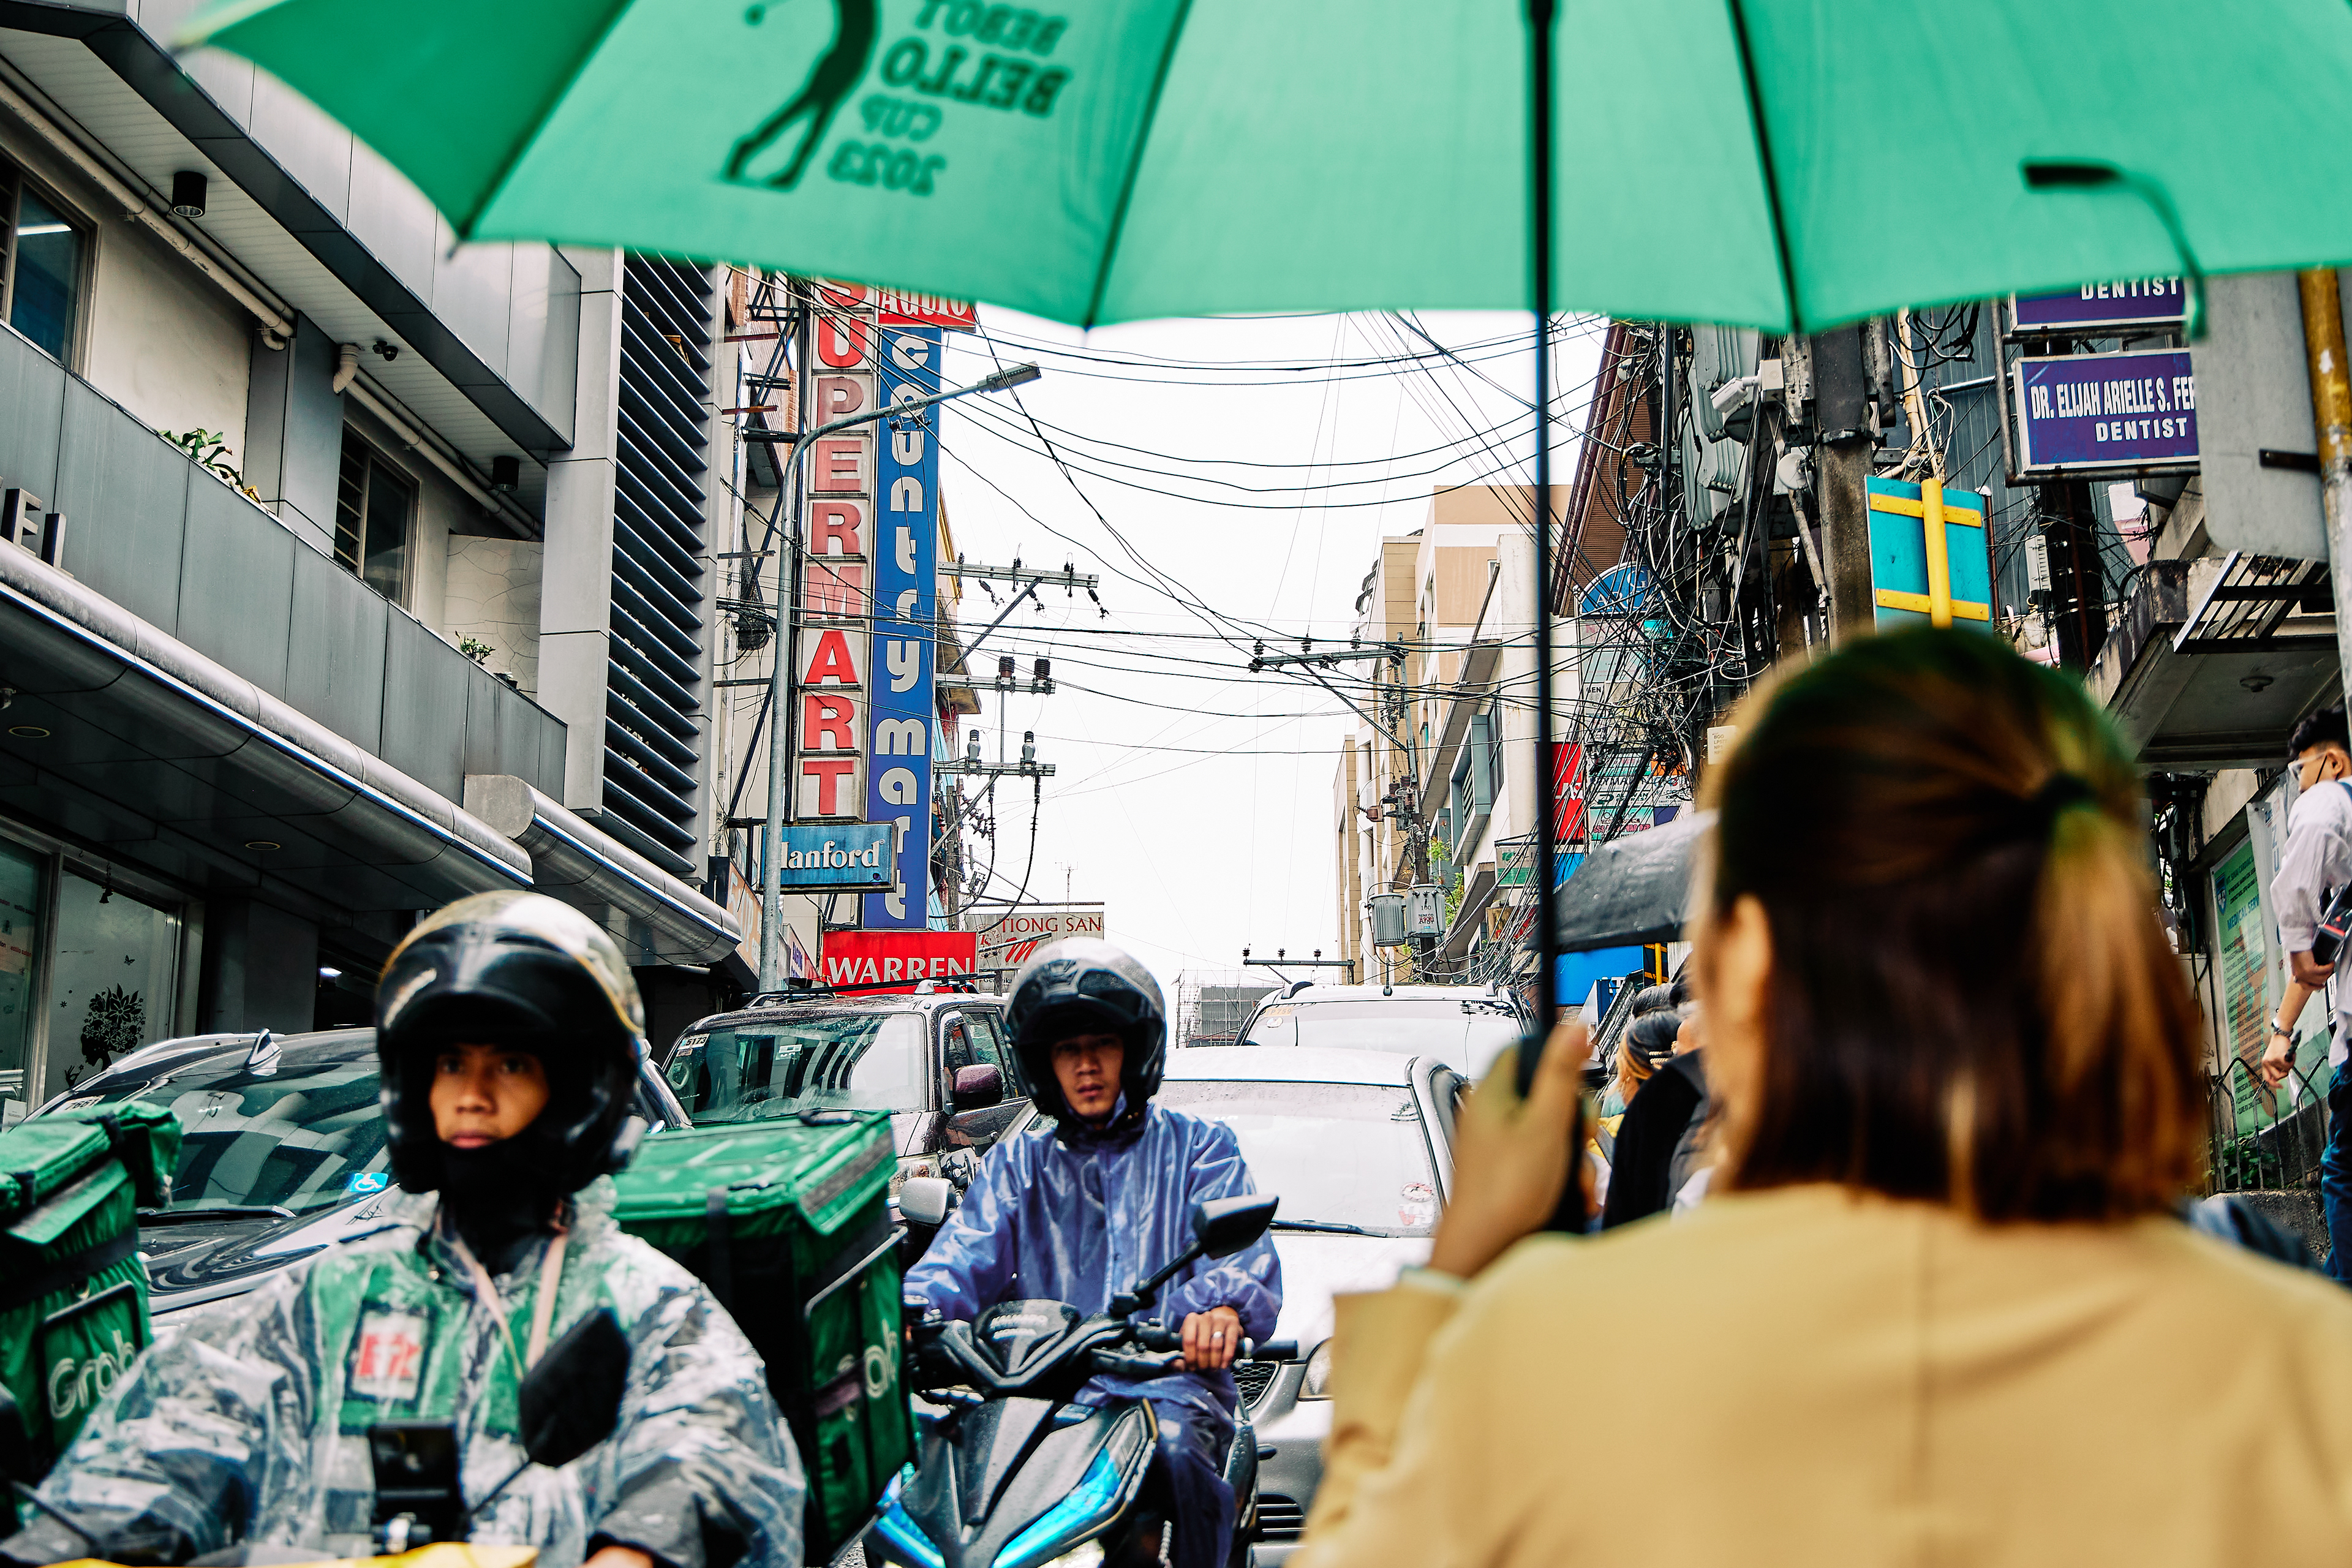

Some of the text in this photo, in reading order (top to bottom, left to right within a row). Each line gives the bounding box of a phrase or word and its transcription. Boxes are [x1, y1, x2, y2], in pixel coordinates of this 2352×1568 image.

[2081, 276, 2179, 300] DENTIST
[2030, 385, 2055, 420] DR.
[2056, 382, 2101, 418] ELIJAH
[2103, 378, 2155, 415] ARIELLE
[2155, 377, 2171, 413] S.
[2095, 417, 2188, 442] DENTIST
[0, 476, 75, 578] EL
[999, 916, 1102, 933] TIONG SAN
[827, 957, 970, 984] WARREN
[48, 1329, 135, 1420] Grab
